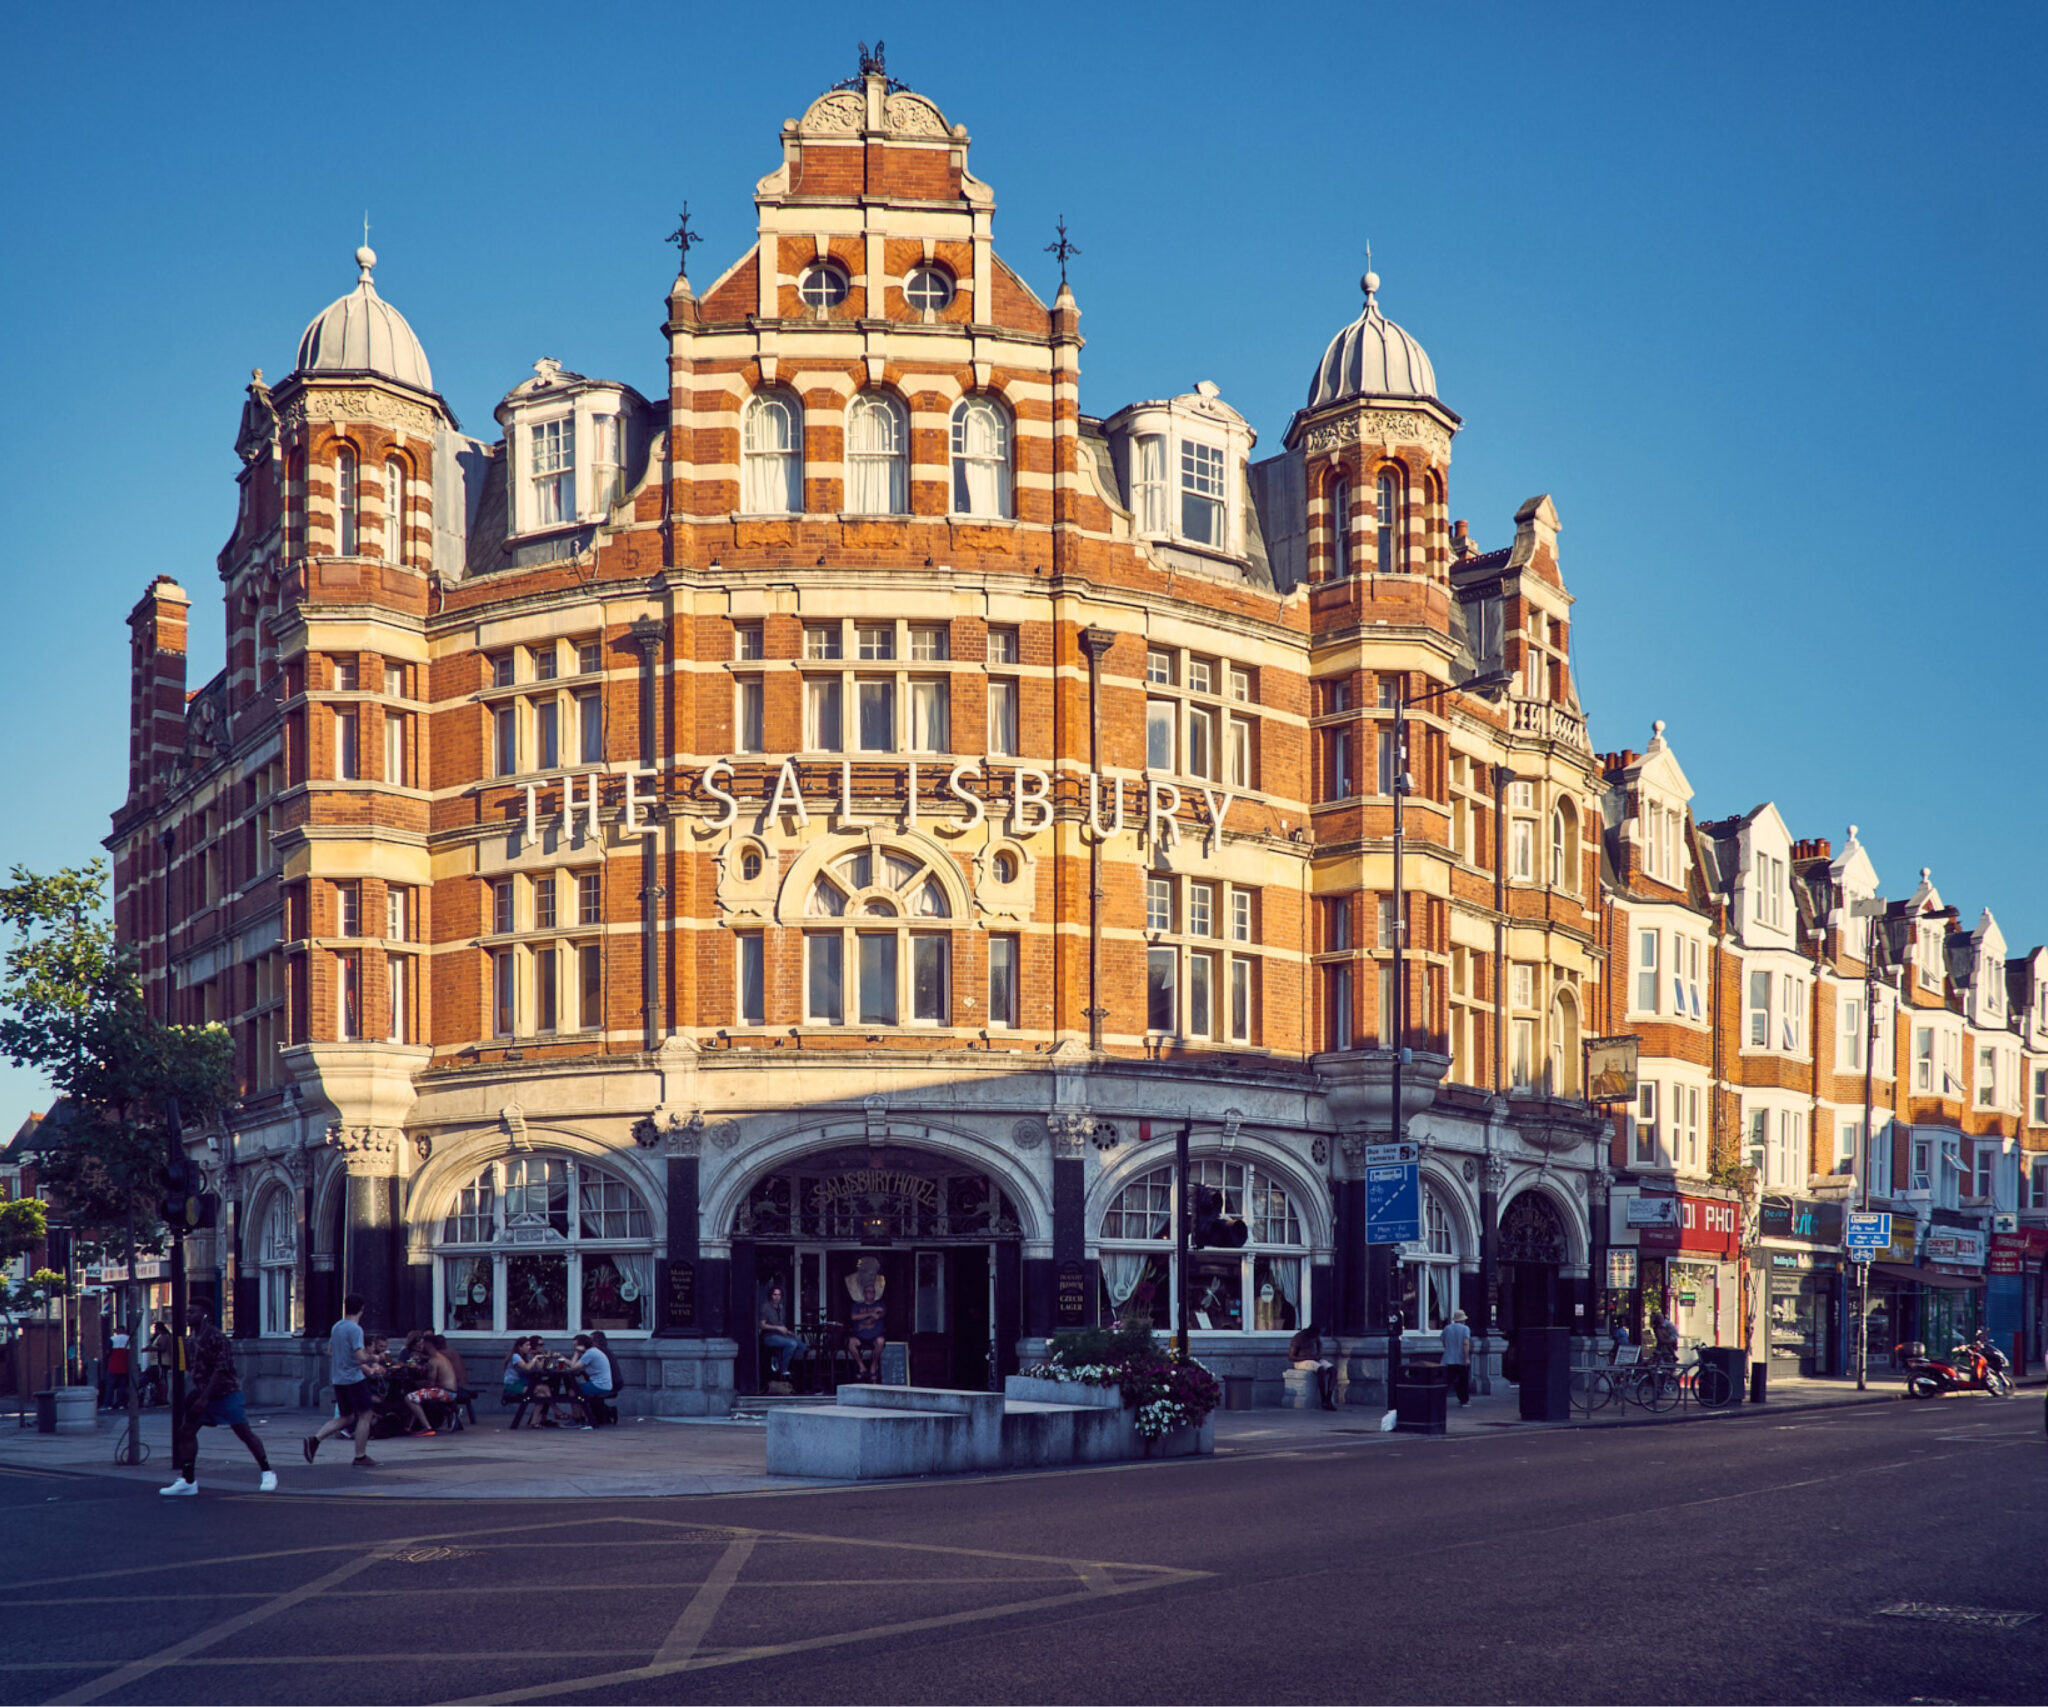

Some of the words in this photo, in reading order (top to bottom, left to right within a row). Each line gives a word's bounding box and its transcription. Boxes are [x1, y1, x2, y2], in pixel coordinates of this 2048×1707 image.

[516, 768, 660, 845] THE
[702, 761, 1234, 851] SALISBURY
[1367, 1147, 1379, 1155] Bus
[813, 1169, 892, 1204] SALISBURY
[892, 1172, 937, 1206] HOTEL
[1705, 1205, 1734, 1233] PHO
